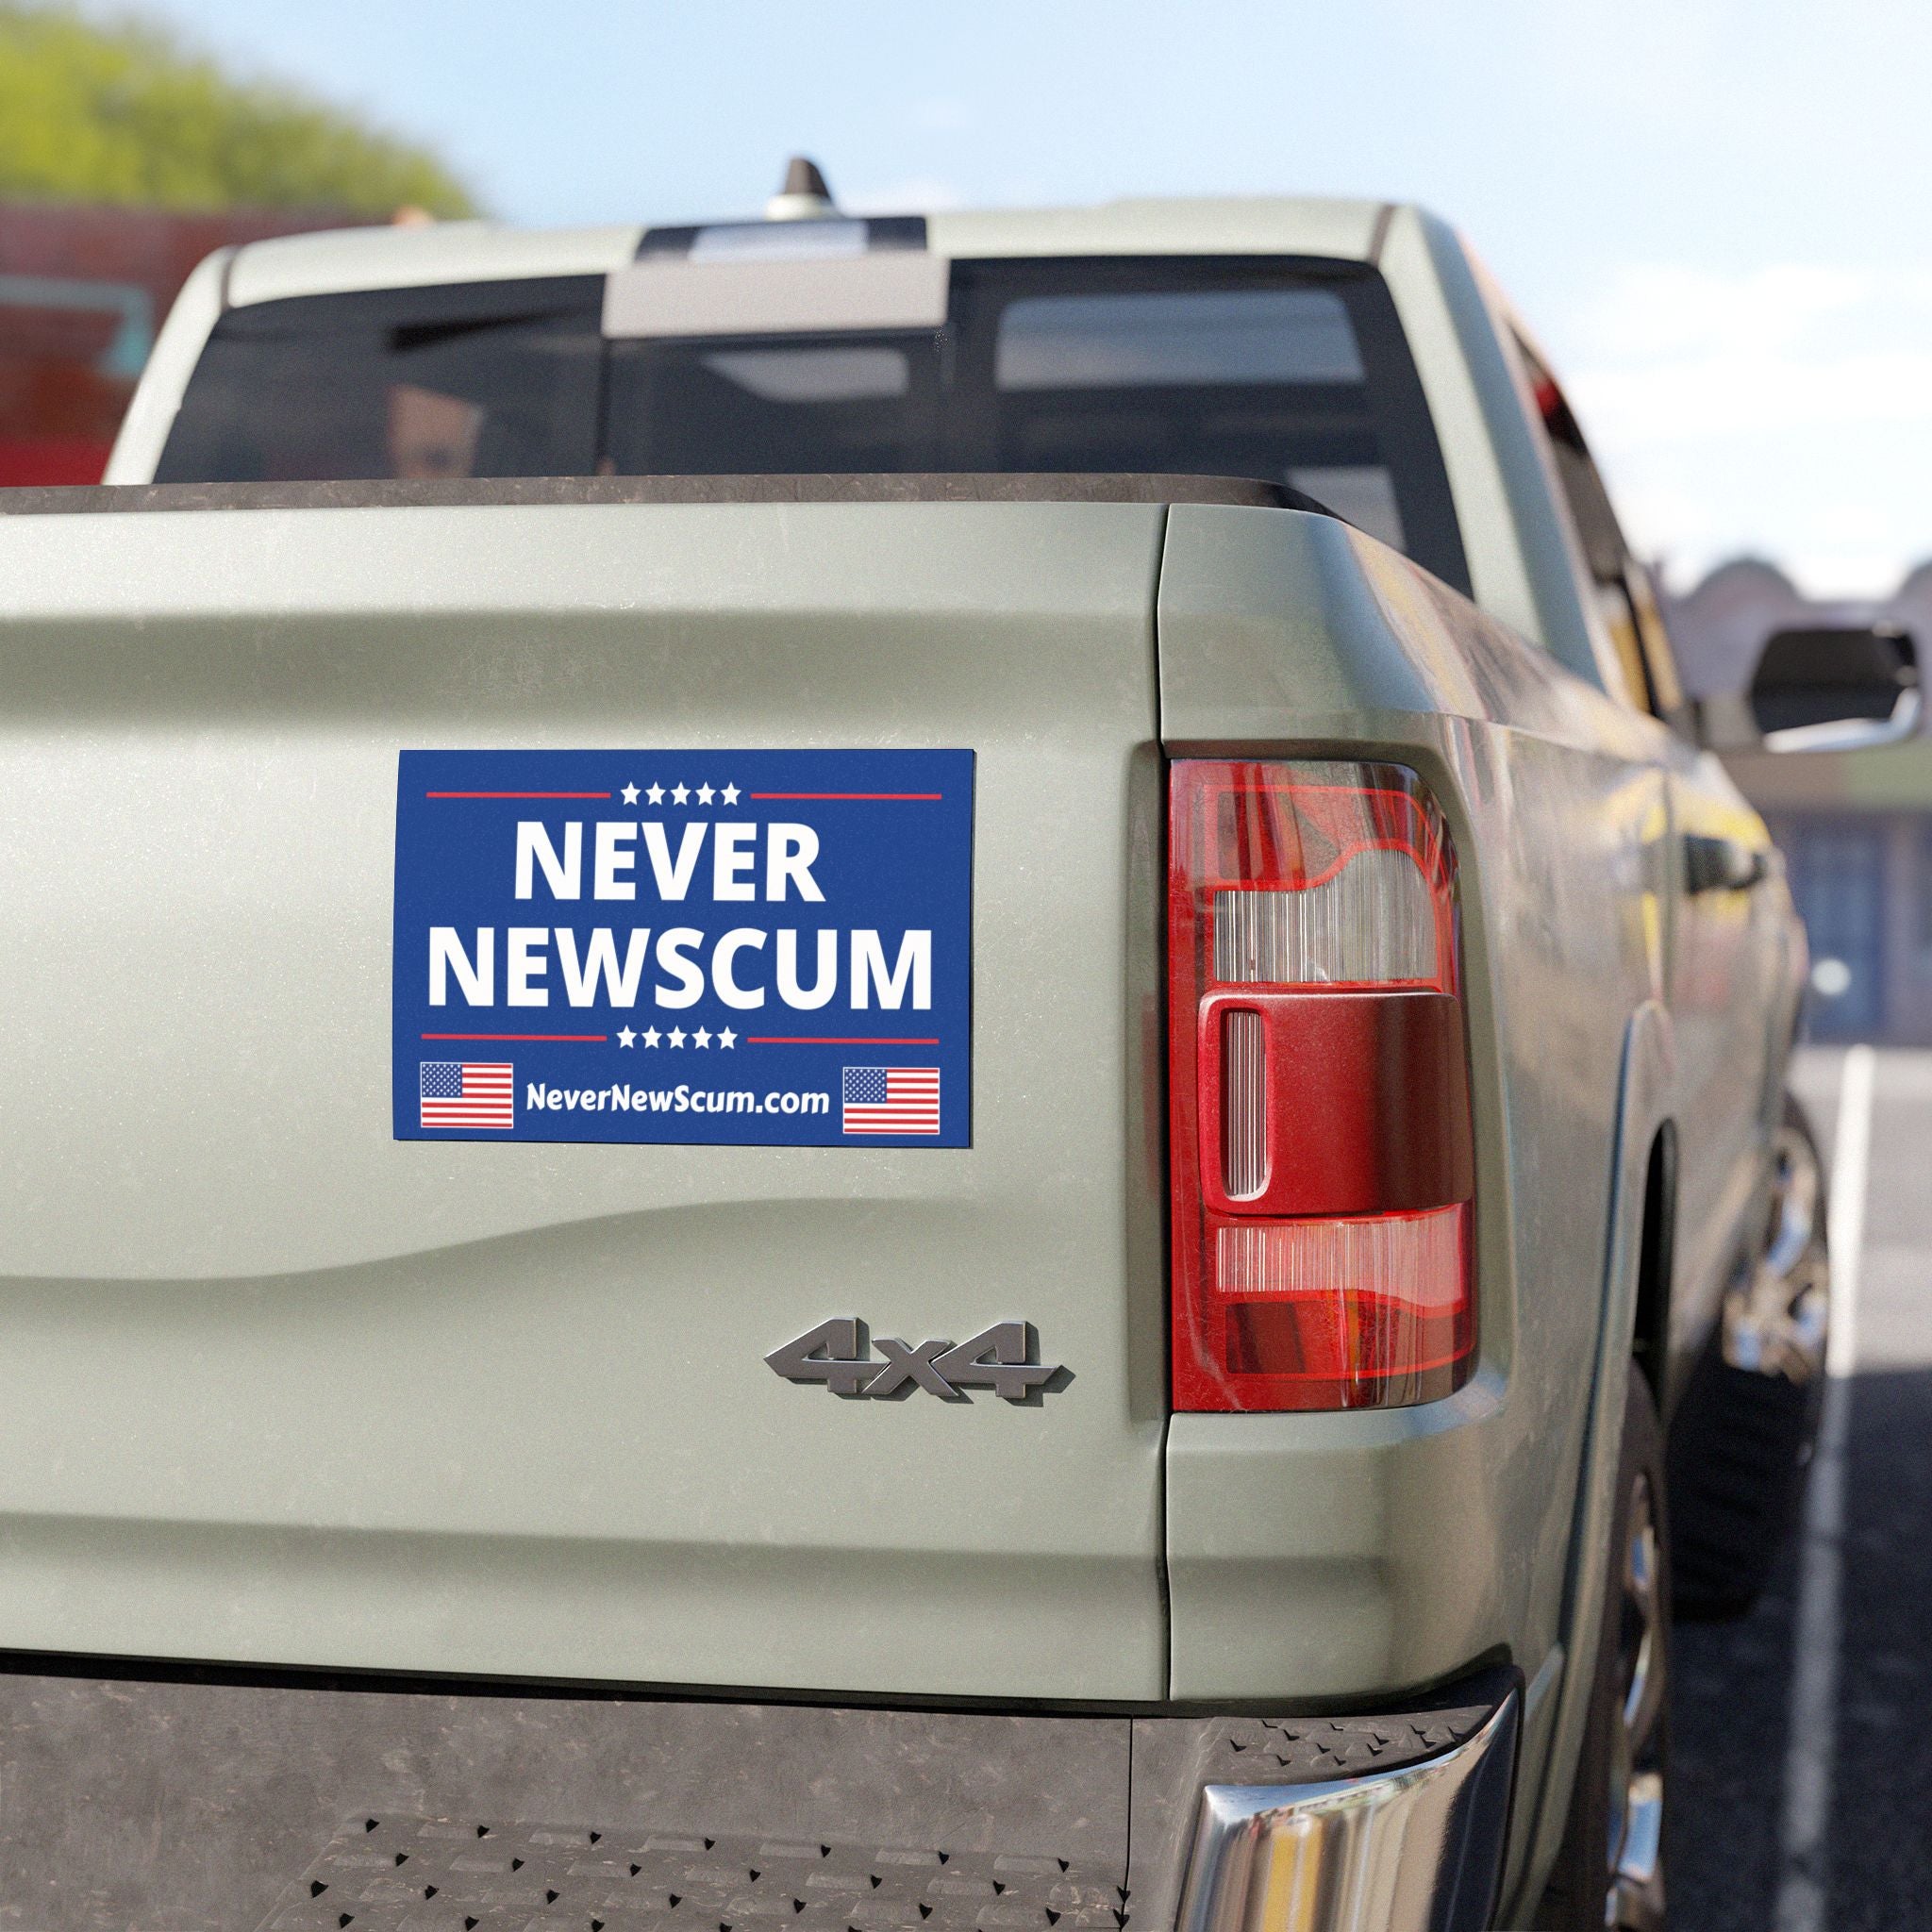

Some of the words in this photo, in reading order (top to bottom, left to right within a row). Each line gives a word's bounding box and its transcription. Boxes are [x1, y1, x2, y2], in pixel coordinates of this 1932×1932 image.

[514, 821, 826, 902] NEVER
[427, 926, 932, 1010] NEWSCUM
[525, 1082, 830, 1115] NeverNewScum.com
[763, 1317, 1062, 1399] 4x4
